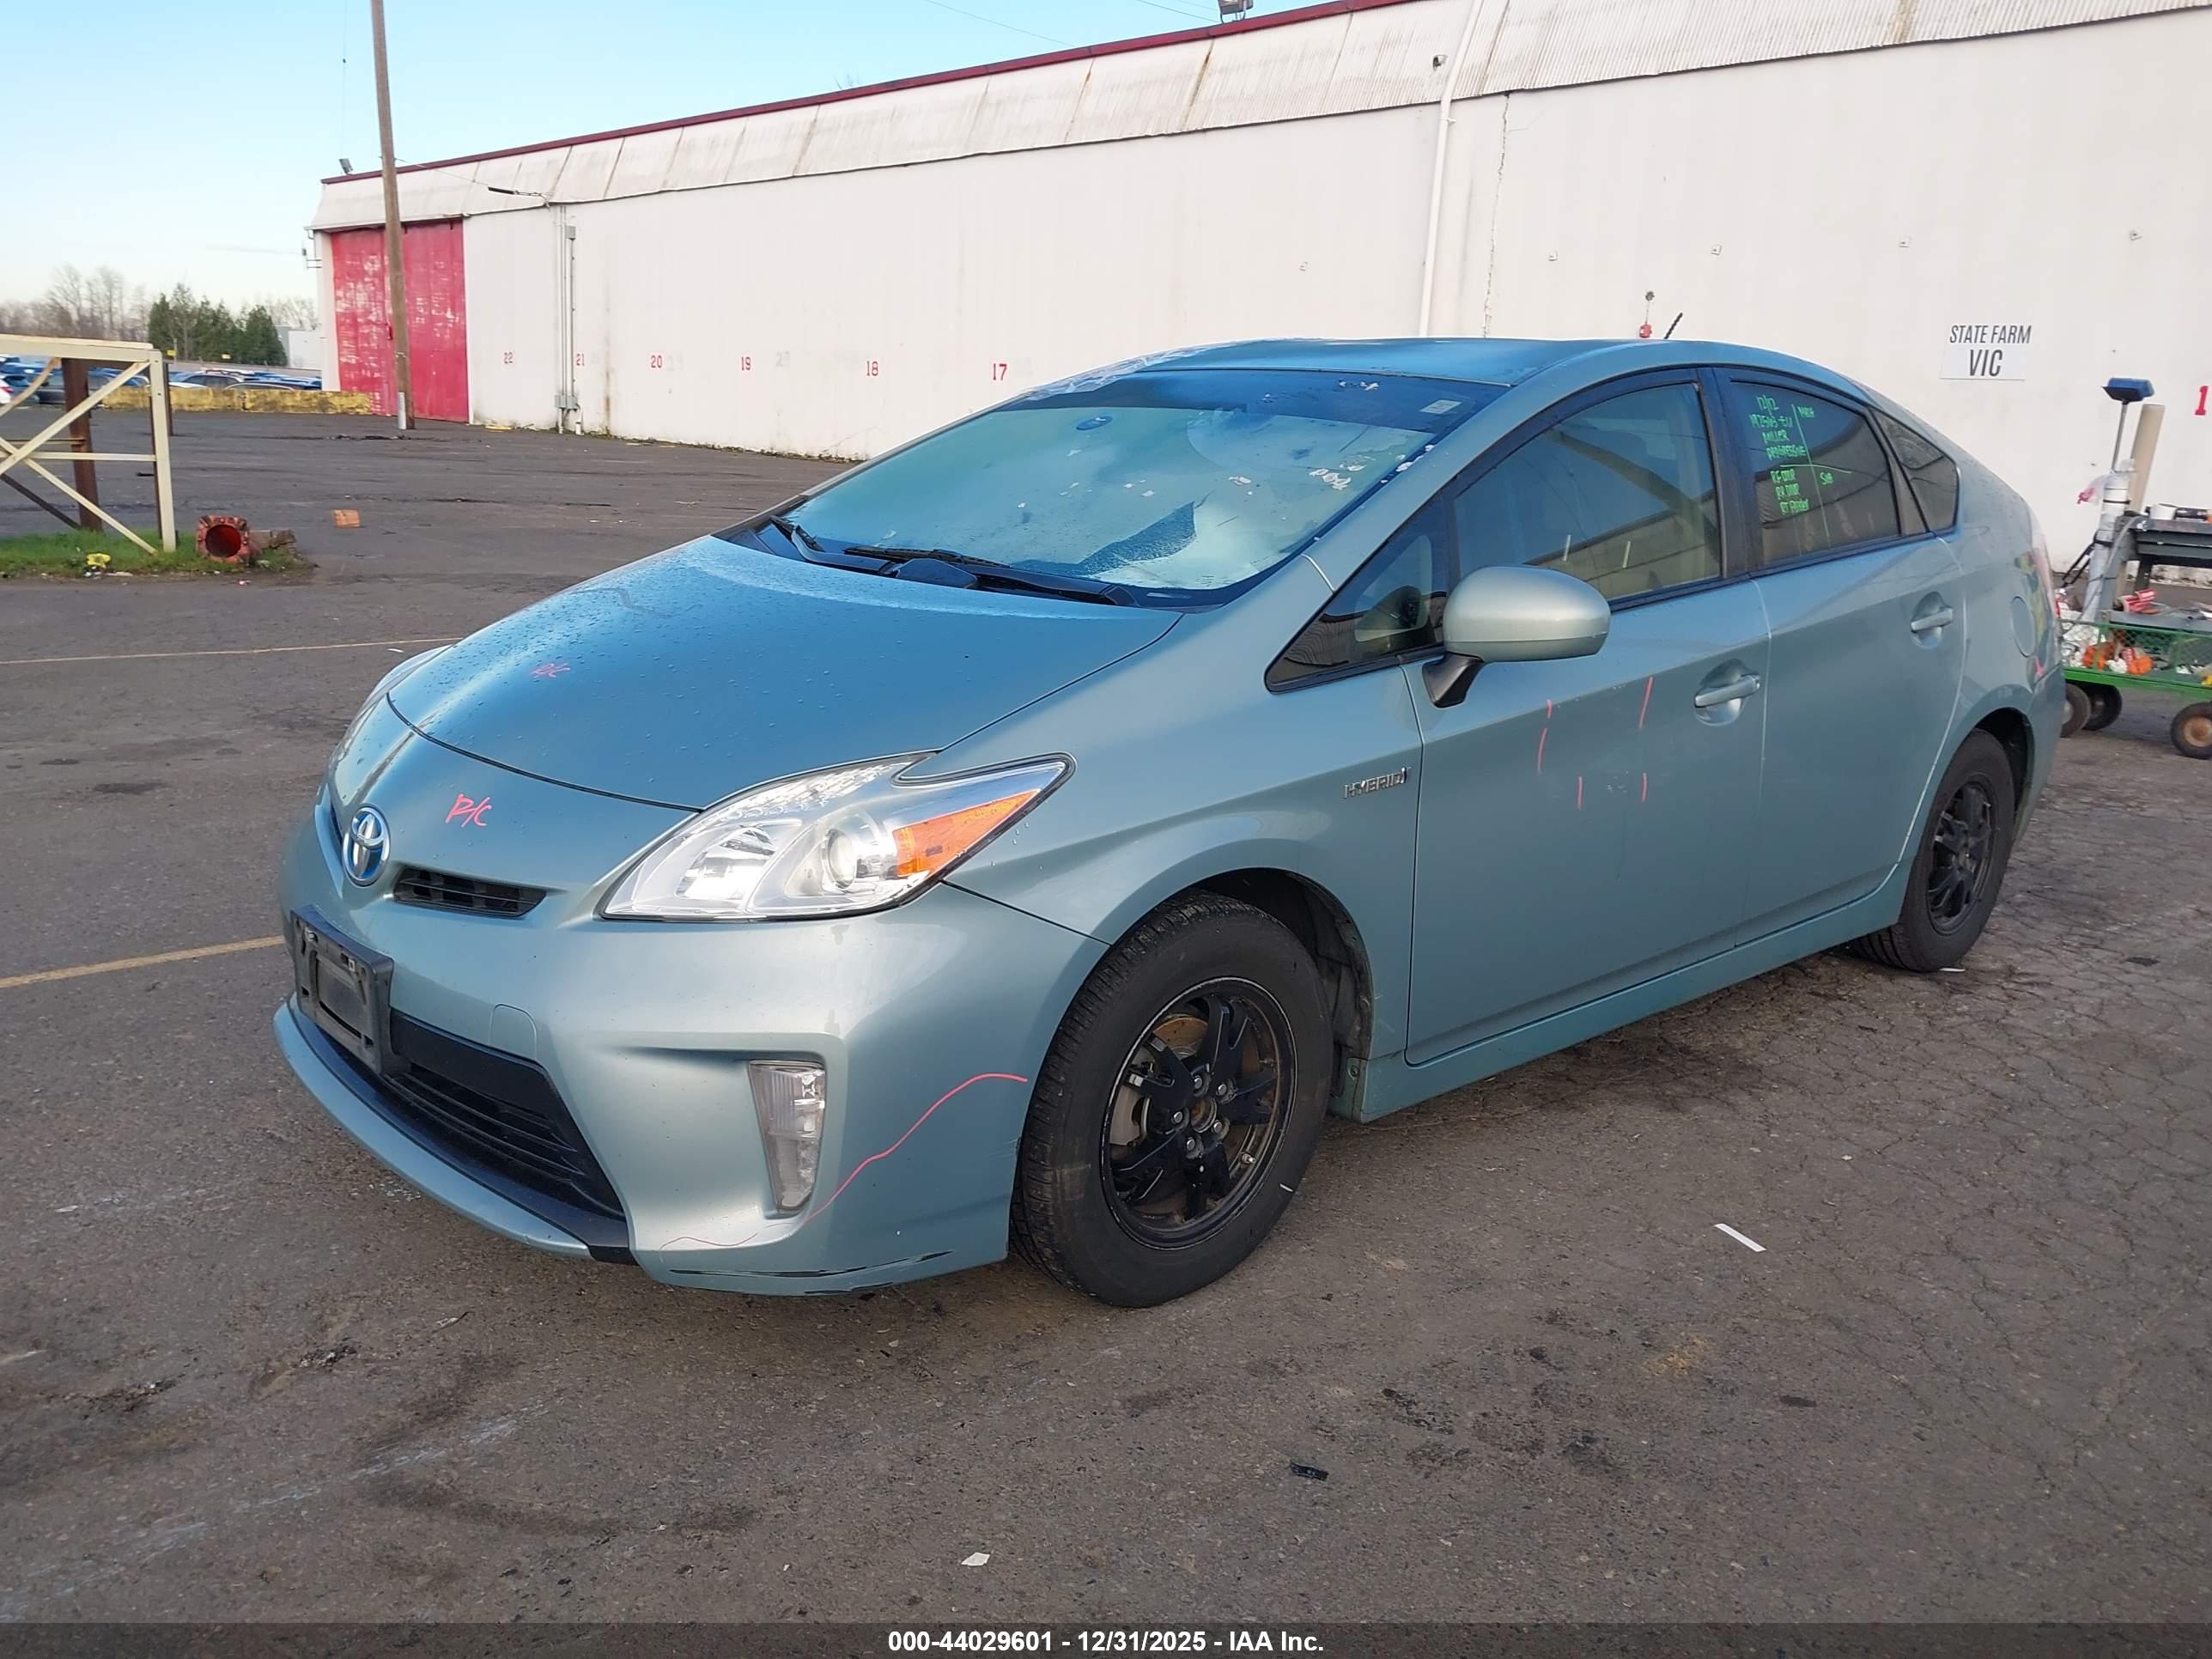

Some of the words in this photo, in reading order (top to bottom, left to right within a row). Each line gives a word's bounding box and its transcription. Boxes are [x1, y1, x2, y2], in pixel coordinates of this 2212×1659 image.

[1949, 325, 1989, 343] STATE
[1991, 325, 2033, 344] FARM
[650, 355, 663, 369] 20
[740, 356, 752, 371] 19
[866, 361, 879, 377] 18
[1969, 349, 2003, 377] VIC
[992, 363, 1008, 381] 17
[1342, 767, 1410, 799] HYBRID
